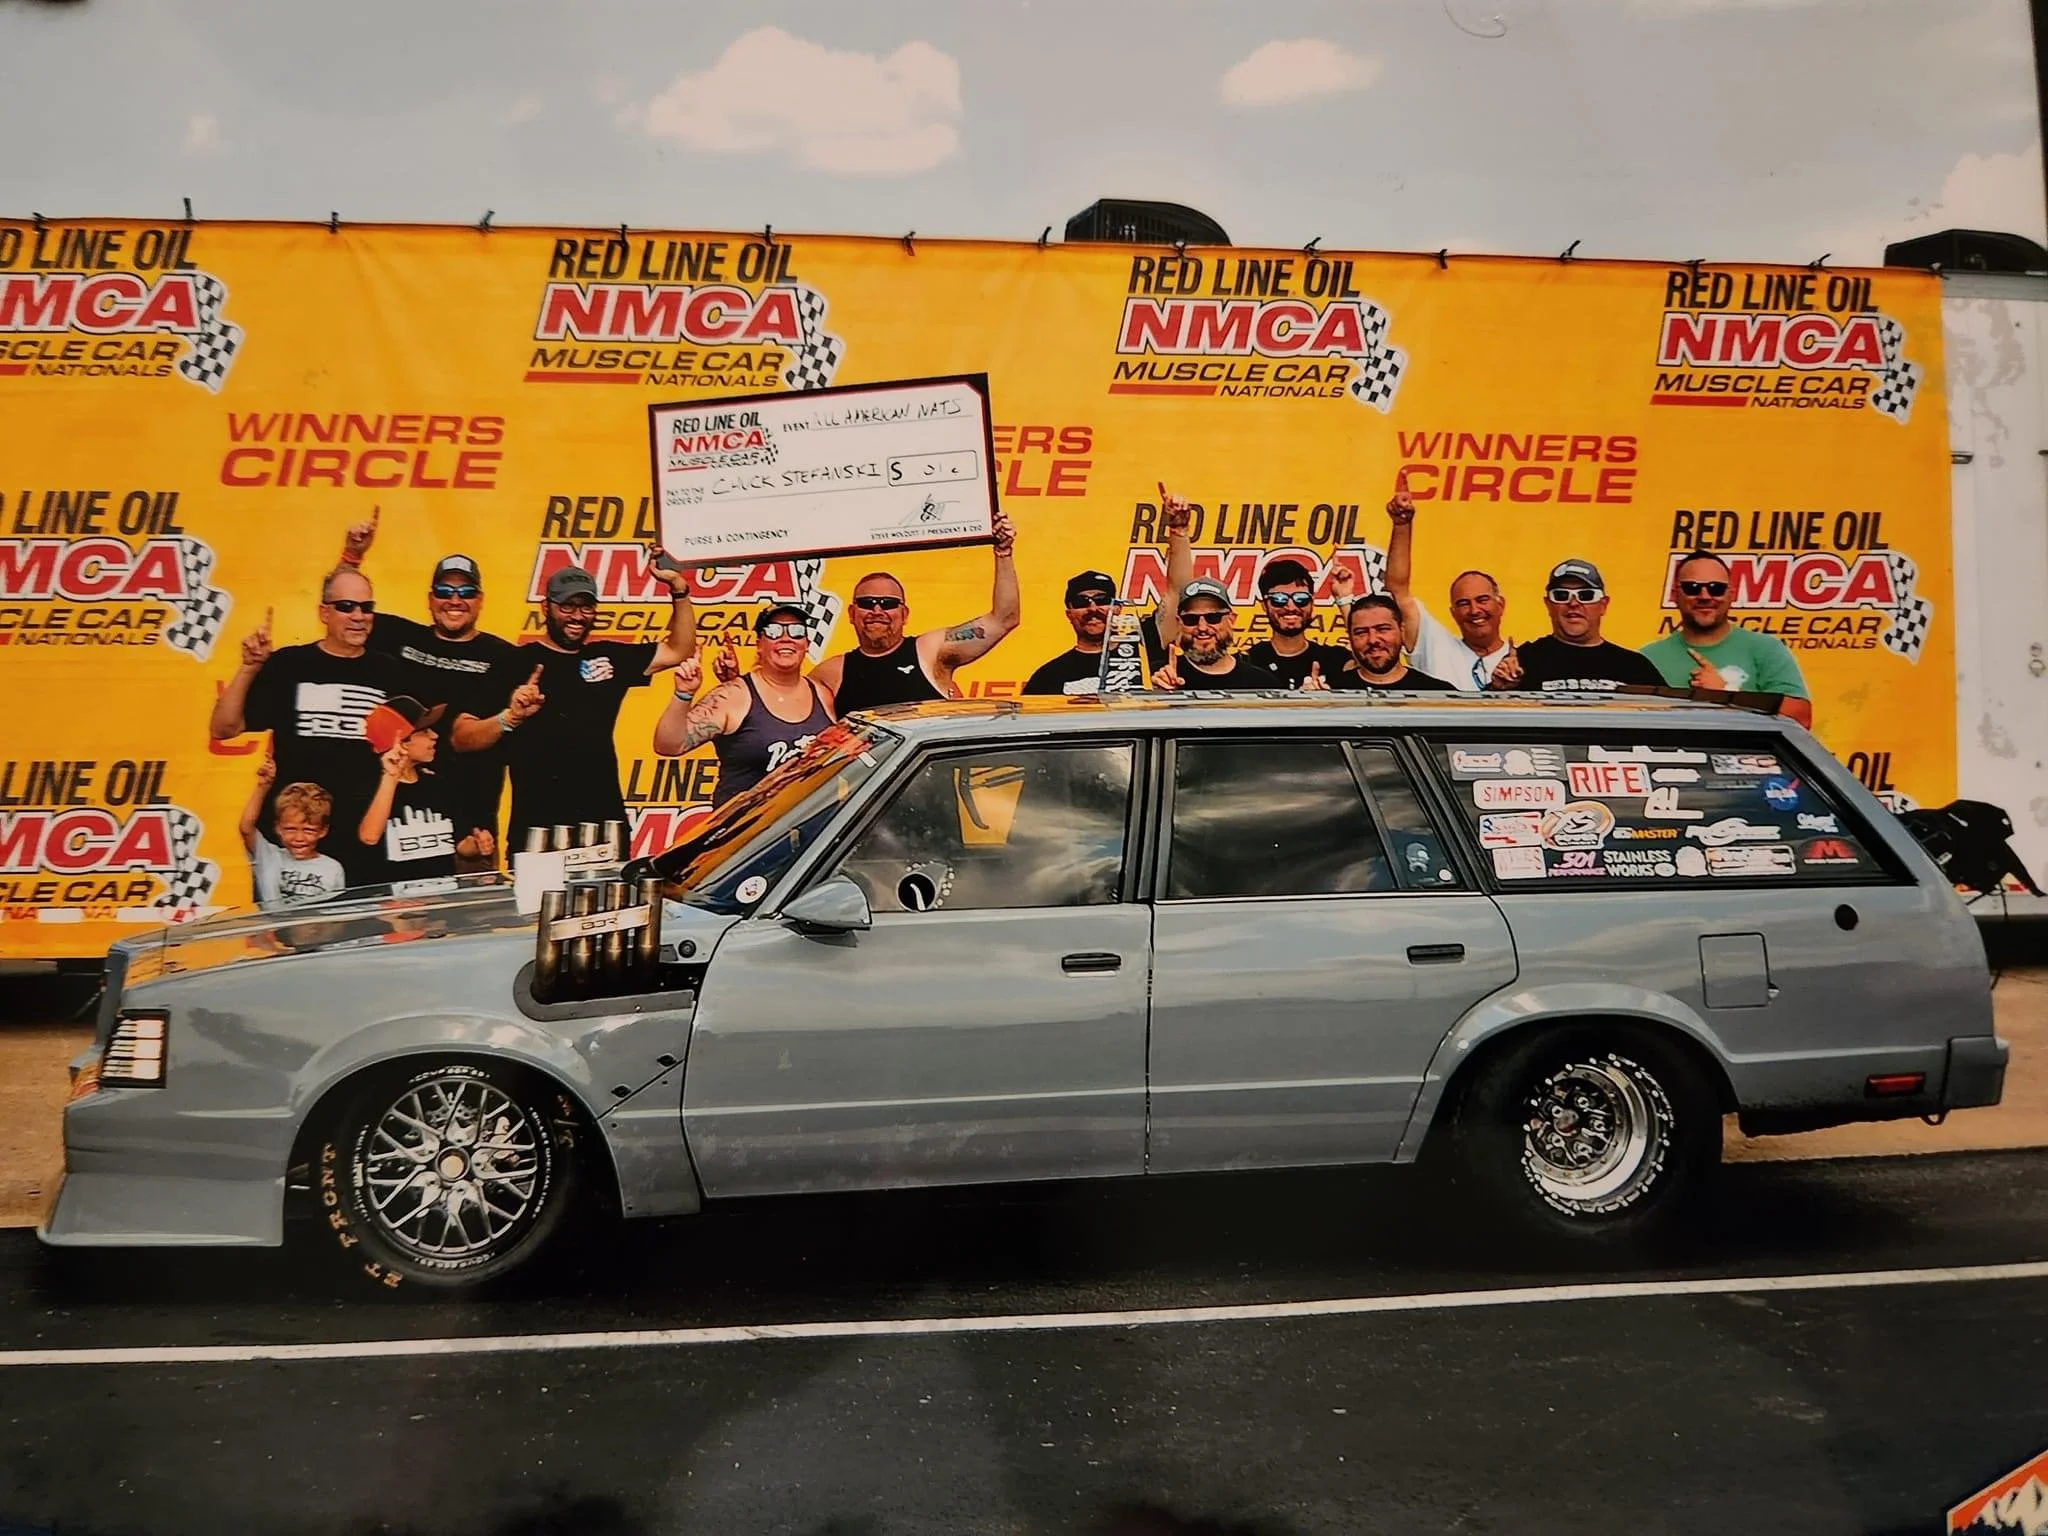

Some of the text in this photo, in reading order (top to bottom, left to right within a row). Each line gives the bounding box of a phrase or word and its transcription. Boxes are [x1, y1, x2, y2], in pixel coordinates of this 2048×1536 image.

[30, 228, 126, 270] LINE
[133, 229, 198, 270] OIL
[548, 239, 799, 284] RED LINE OIL
[1128, 256, 1361, 298] RED LINE OIL
[1664, 271, 1879, 313] RED LINE OIL
[535, 284, 804, 346] NMCA
[1118, 299, 1370, 356] NMCA
[92, 341, 179, 362] CAR
[1658, 313, 1887, 371] NMCA
[30, 364, 173, 377] NATIONALS
[530, 348, 785, 372] MUSCLE CAR
[1114, 361, 1351, 383] MUSCLE CAR
[644, 373, 778, 388] NATIONALS
[1220, 384, 1344, 398] NATIONALS
[1654, 373, 1871, 395] MUSCLE CAR
[1750, 396, 1866, 409] NATIONALS
[228, 413, 505, 445] WINNERS
[673, 412, 762, 434] RED LINE OIL
[672, 431, 765, 455] NMCA
[1397, 432, 1637, 463] WINNERS
[220, 448, 503, 489] CIRCLE
[1395, 464, 1637, 503] CIRCLE
[12, 491, 184, 535] LINE OIL
[541, 496, 624, 538] RED
[1214, 504, 1298, 544] LINE
[1308, 504, 1366, 545] OIL
[1670, 510, 1889, 550] RED LINE OIL
[1662, 553, 1900, 610] MCA
[77, 609, 166, 630] CAR
[1807, 617, 1882, 635] CAR
[14, 632, 159, 646] NATIONALS
[0, 760, 173, 806] LINE OIL
[627, 759, 720, 802] LINE
[1571, 766, 1642, 793] RIFE
[1847, 752, 1894, 790] OIL
[1483, 786, 1555, 802] SIMPSON
[1603, 850, 1671, 863] STAINLESS
[1606, 864, 1655, 876] WORKS
[62, 881, 154, 902] CAR
